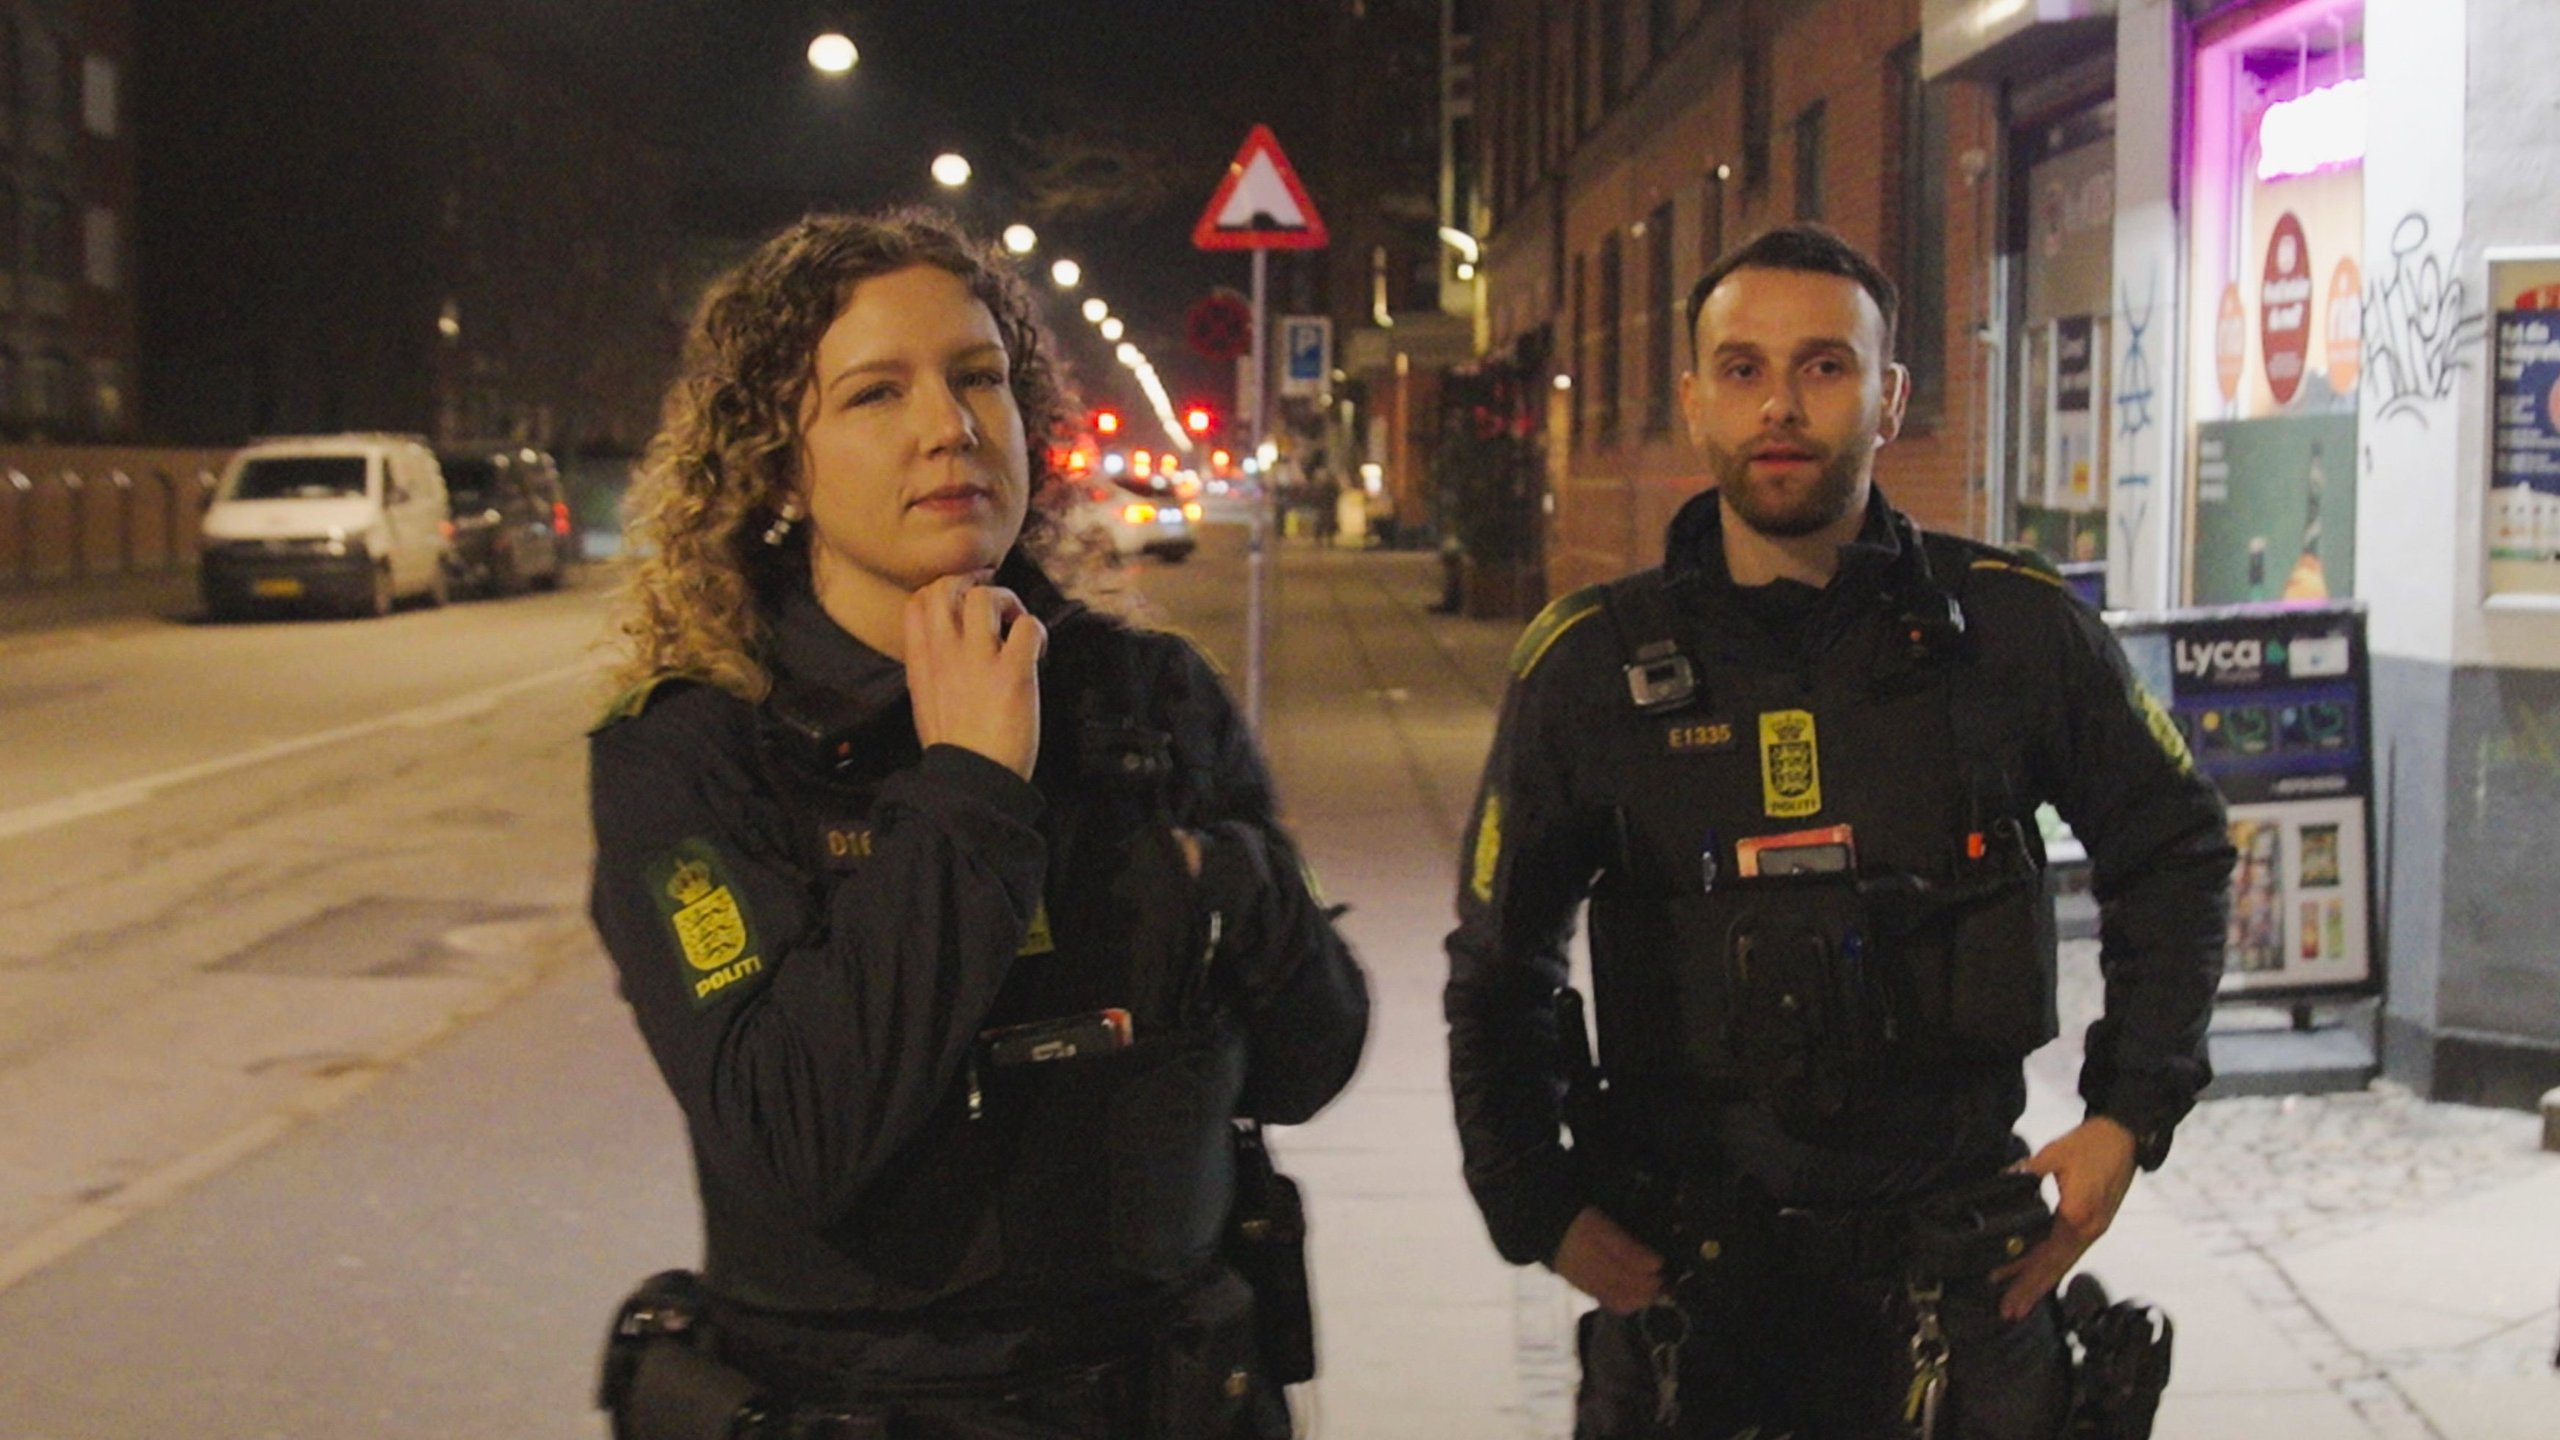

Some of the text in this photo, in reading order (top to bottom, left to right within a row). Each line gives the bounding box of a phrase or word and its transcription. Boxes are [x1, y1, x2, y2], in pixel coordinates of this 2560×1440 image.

[2176, 639, 2261, 677] Lyca
[1669, 724, 1732, 747] E1335
[695, 955, 762, 999] POLITI
